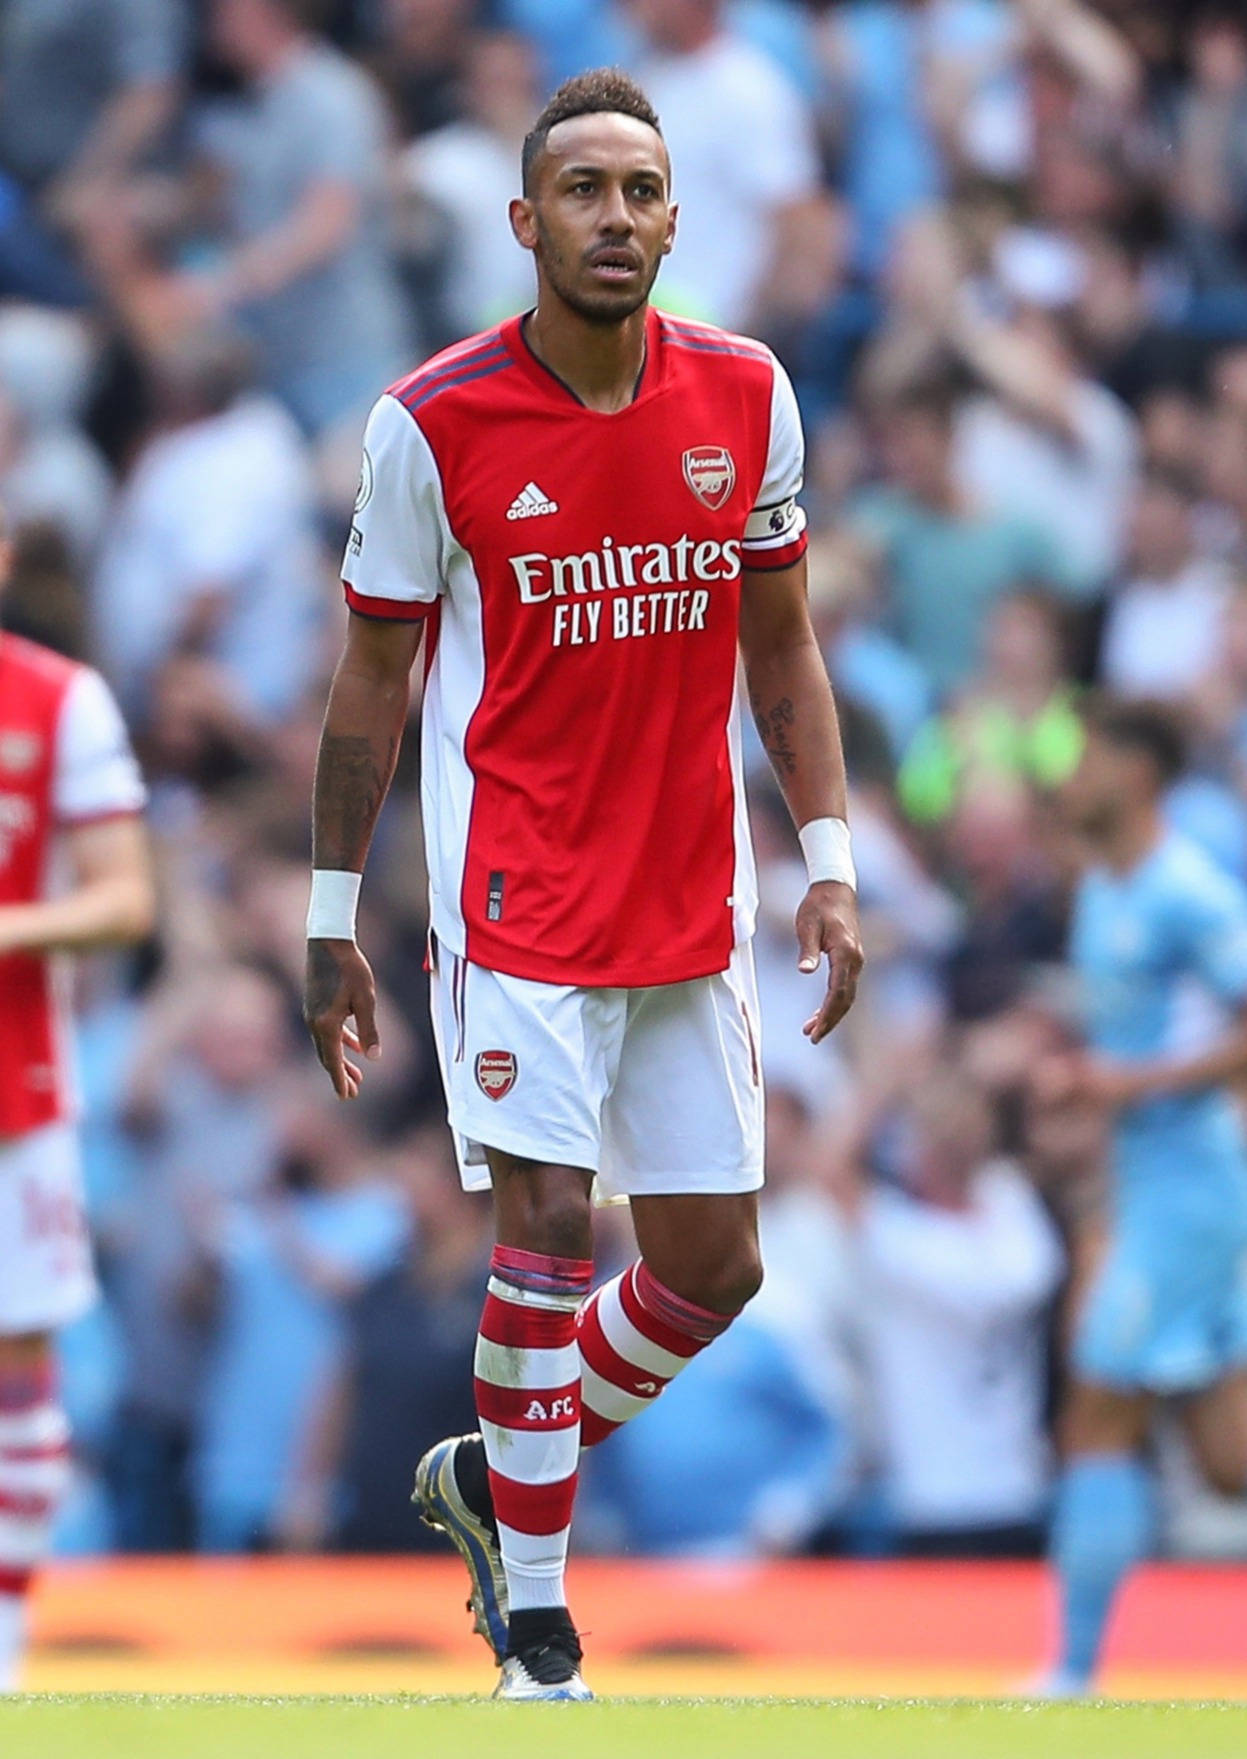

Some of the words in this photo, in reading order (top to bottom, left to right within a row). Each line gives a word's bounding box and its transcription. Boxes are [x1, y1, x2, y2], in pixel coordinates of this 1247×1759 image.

[689, 457, 726, 468] Arsenal
[506, 500, 558, 521] adidas
[508, 533, 741, 604] Emirates
[552, 600, 602, 647] FLY
[612, 590, 709, 640] BETTER
[523, 1395, 574, 1421] AFC
